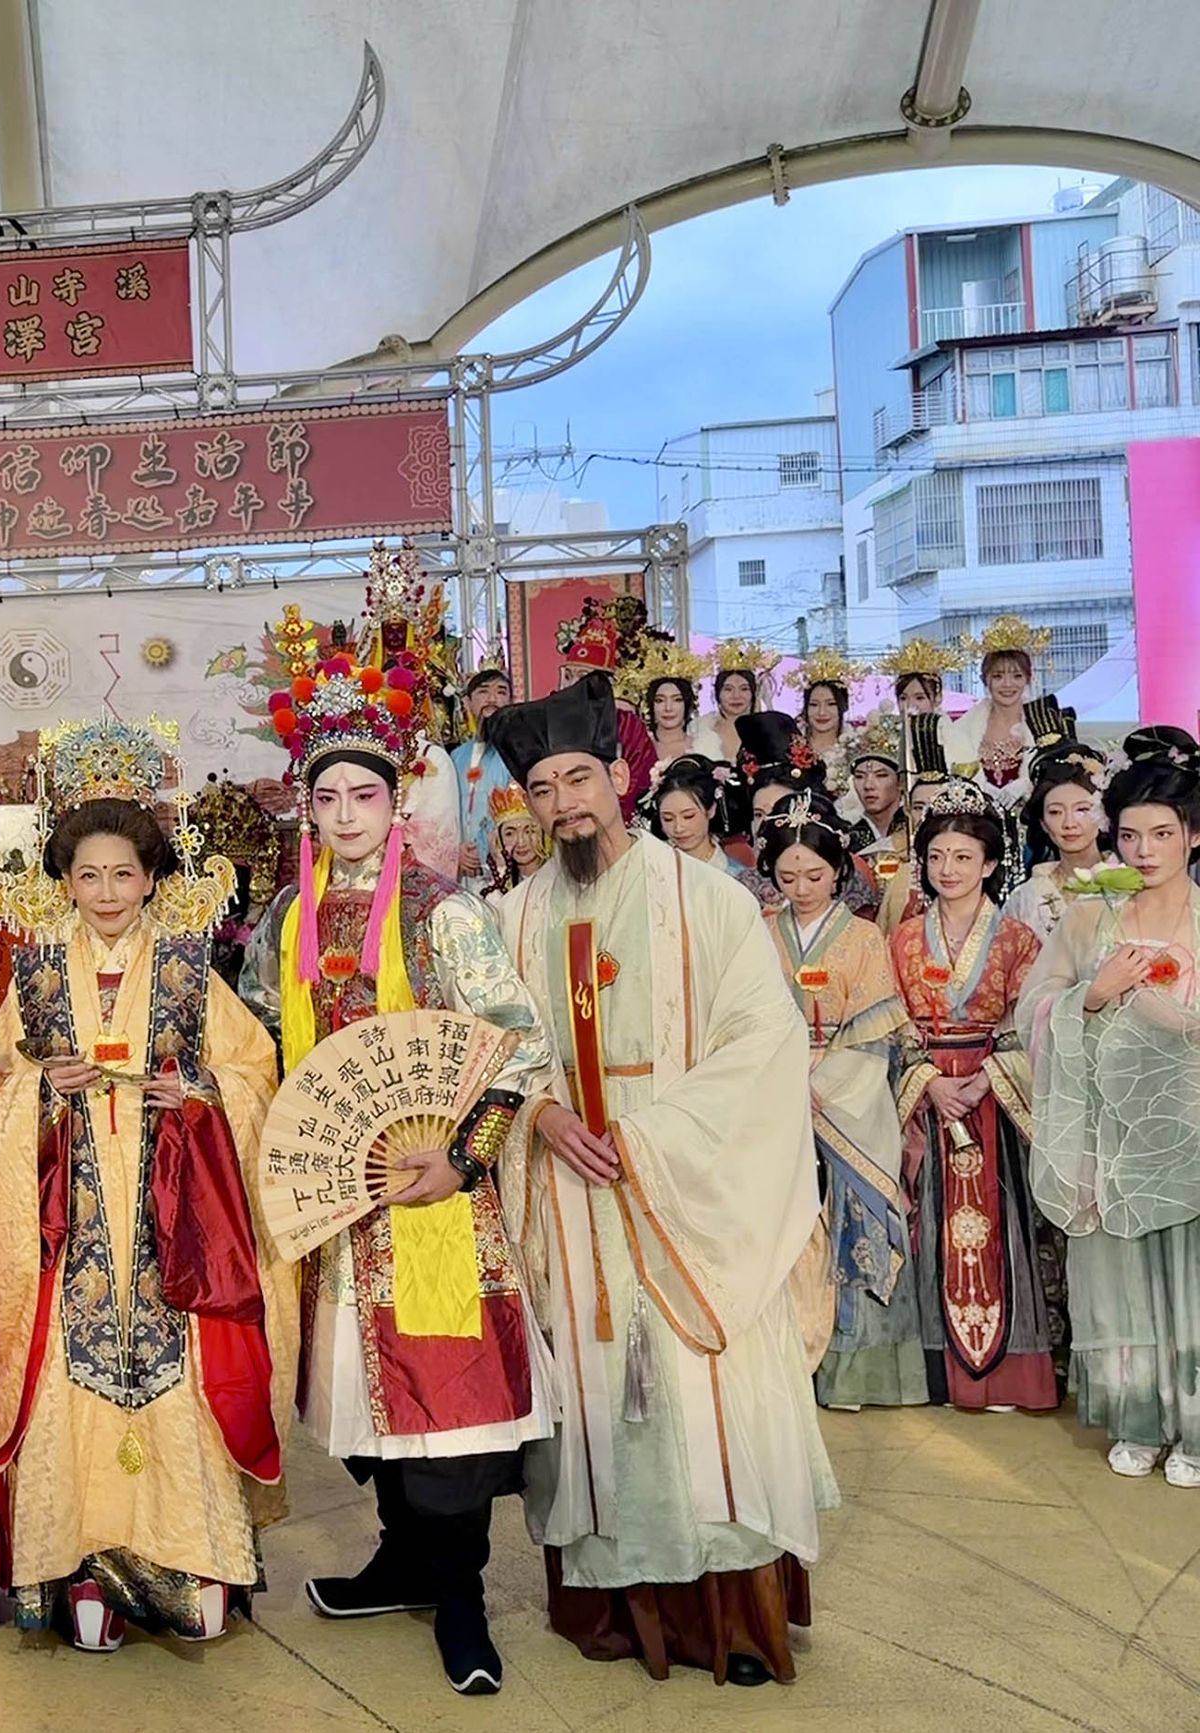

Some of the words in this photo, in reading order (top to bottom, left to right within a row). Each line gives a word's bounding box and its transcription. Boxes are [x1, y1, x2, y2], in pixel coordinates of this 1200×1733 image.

[338, 1056, 390, 1120] 飛鳳山
[357, 1024, 415, 1112] 詩山山頂
[406, 1037, 436, 1106] 南安府
[435, 1019, 471, 1108] 福建泉州
[296, 1069, 374, 1138] 誕生廣澤
[297, 1116, 361, 1155] 仙羽化
[292, 1178, 359, 1213] 下凡間
